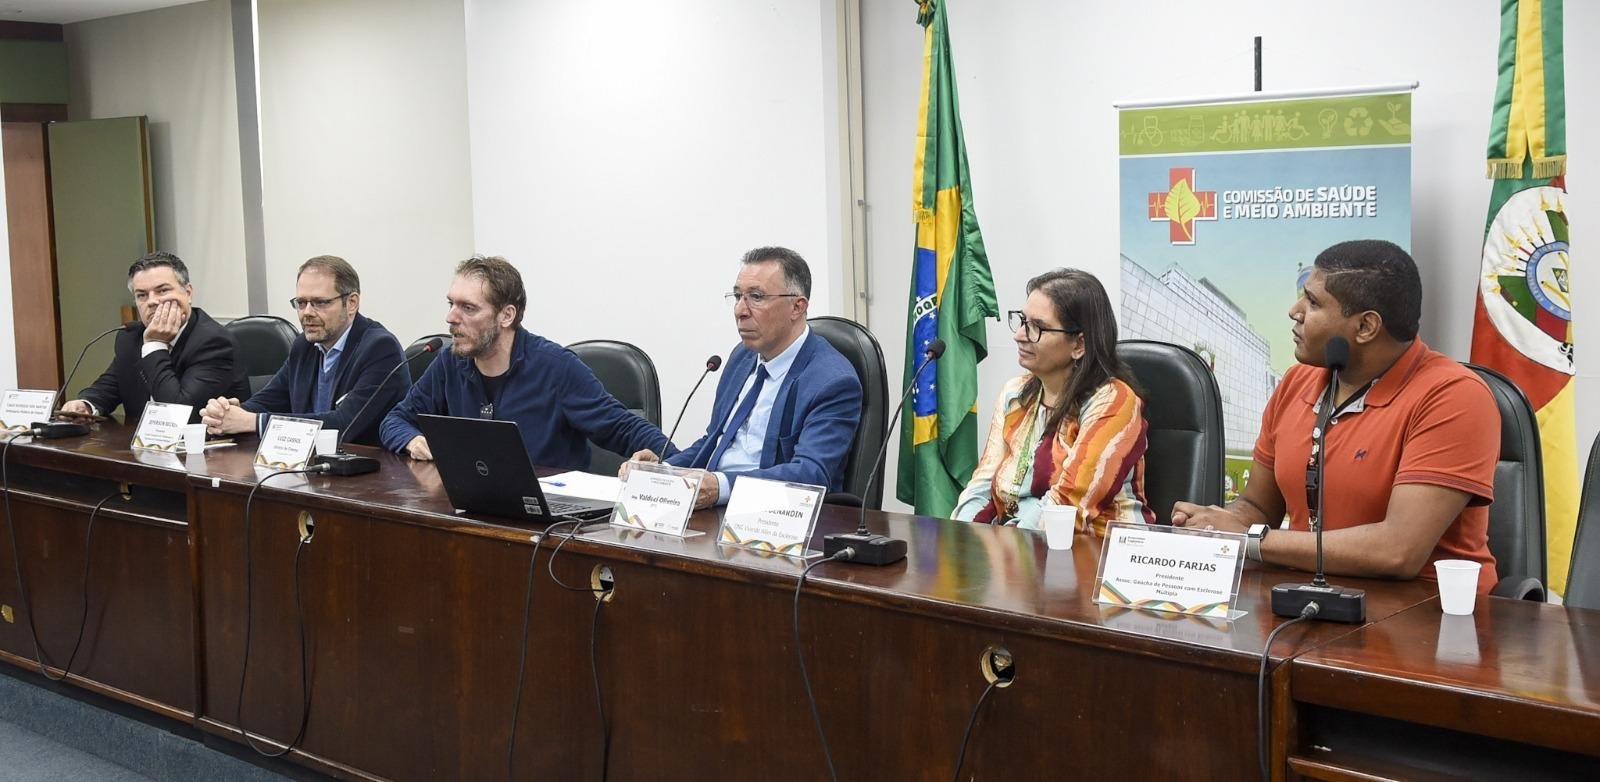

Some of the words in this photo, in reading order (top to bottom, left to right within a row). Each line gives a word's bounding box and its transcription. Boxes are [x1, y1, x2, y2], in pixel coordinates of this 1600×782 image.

[1223, 186, 1294, 204] COMISSÃO
[1295, 188, 1314, 202] DE
[1317, 184, 1377, 202] SAÚDE
[1223, 206, 1232, 219] E
[1235, 203, 1279, 219] MEIO
[1282, 202, 1377, 219] AMBIENTE
[1130, 554, 1176, 568] RICARDO
[1178, 560, 1217, 573] FARIAS
[1155, 573, 1184, 581] Presidente
[1161, 582, 1183, 590] Pessoas
[1197, 586, 1223, 595] Esclerose
